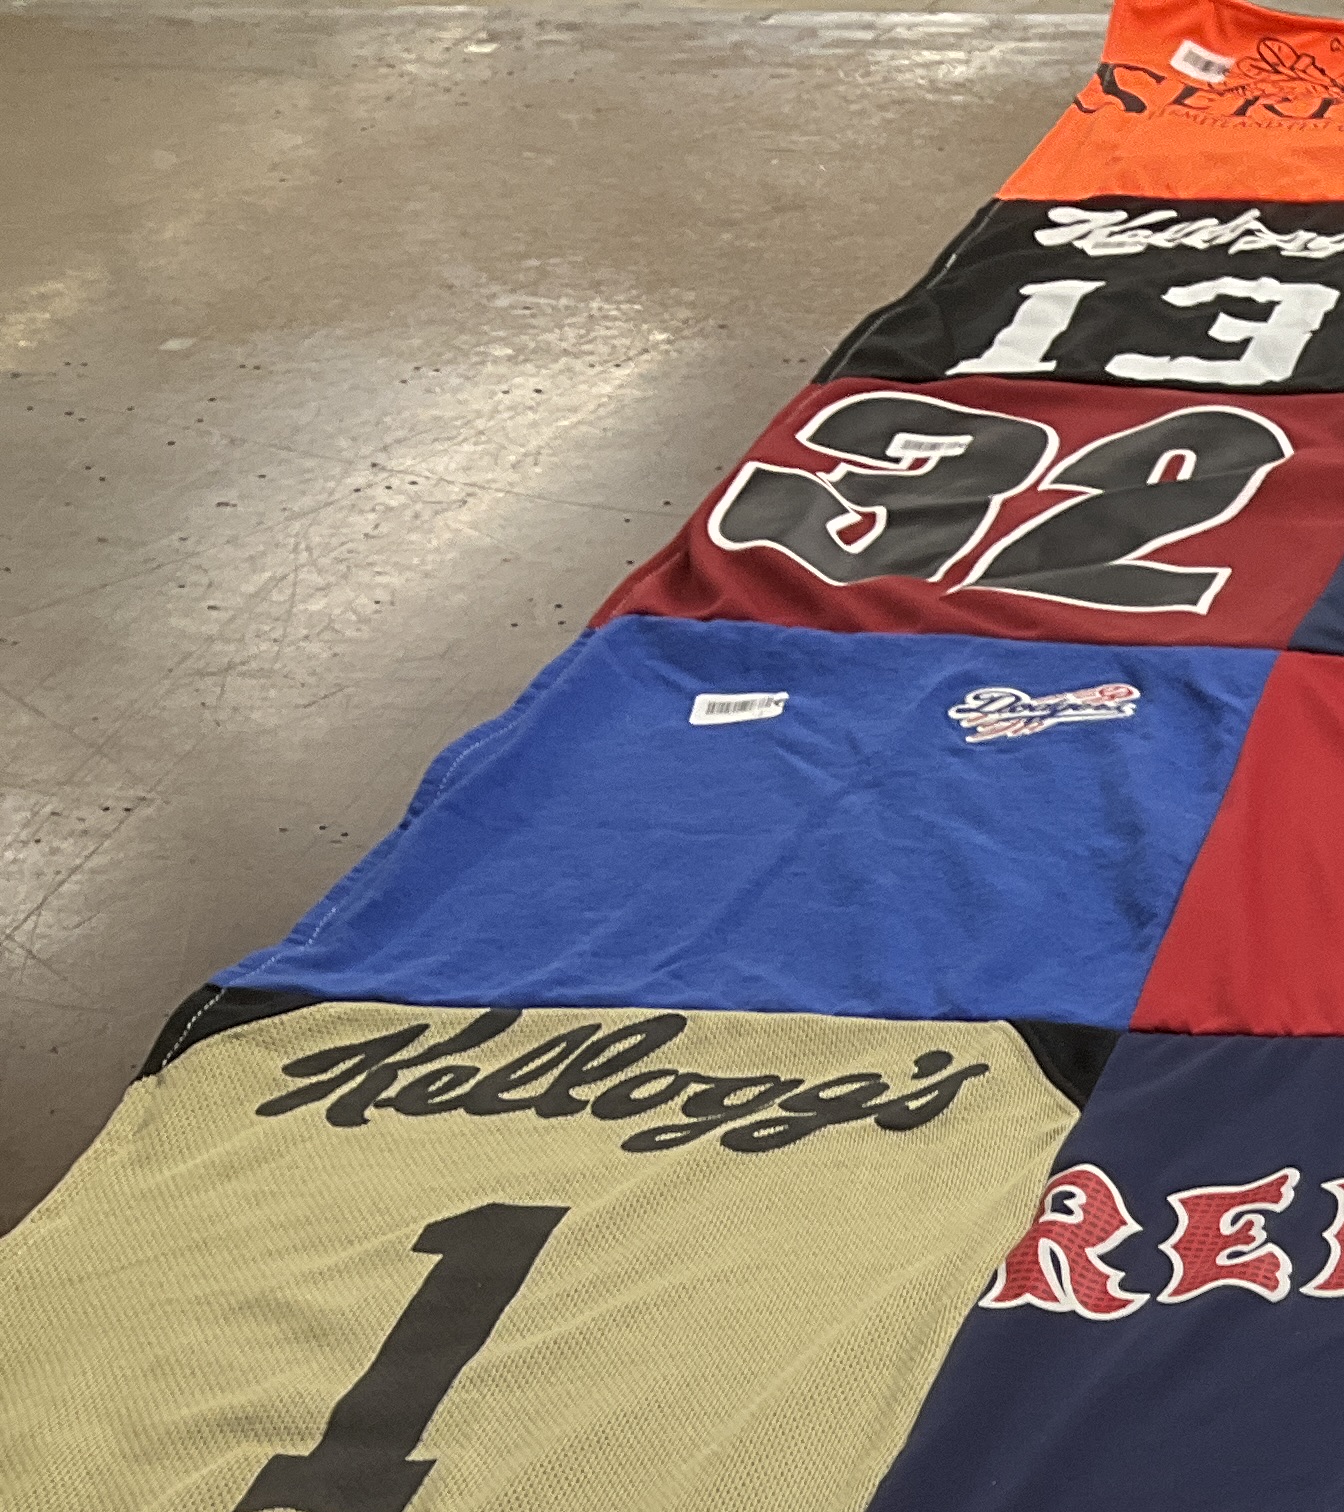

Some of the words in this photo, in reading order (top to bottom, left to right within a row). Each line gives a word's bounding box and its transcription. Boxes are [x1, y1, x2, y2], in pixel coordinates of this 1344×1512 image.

[944, 275, 1341, 386] 13
[707, 391, 1295, 615] 32
[254, 1007, 990, 1153] Kellogg's
